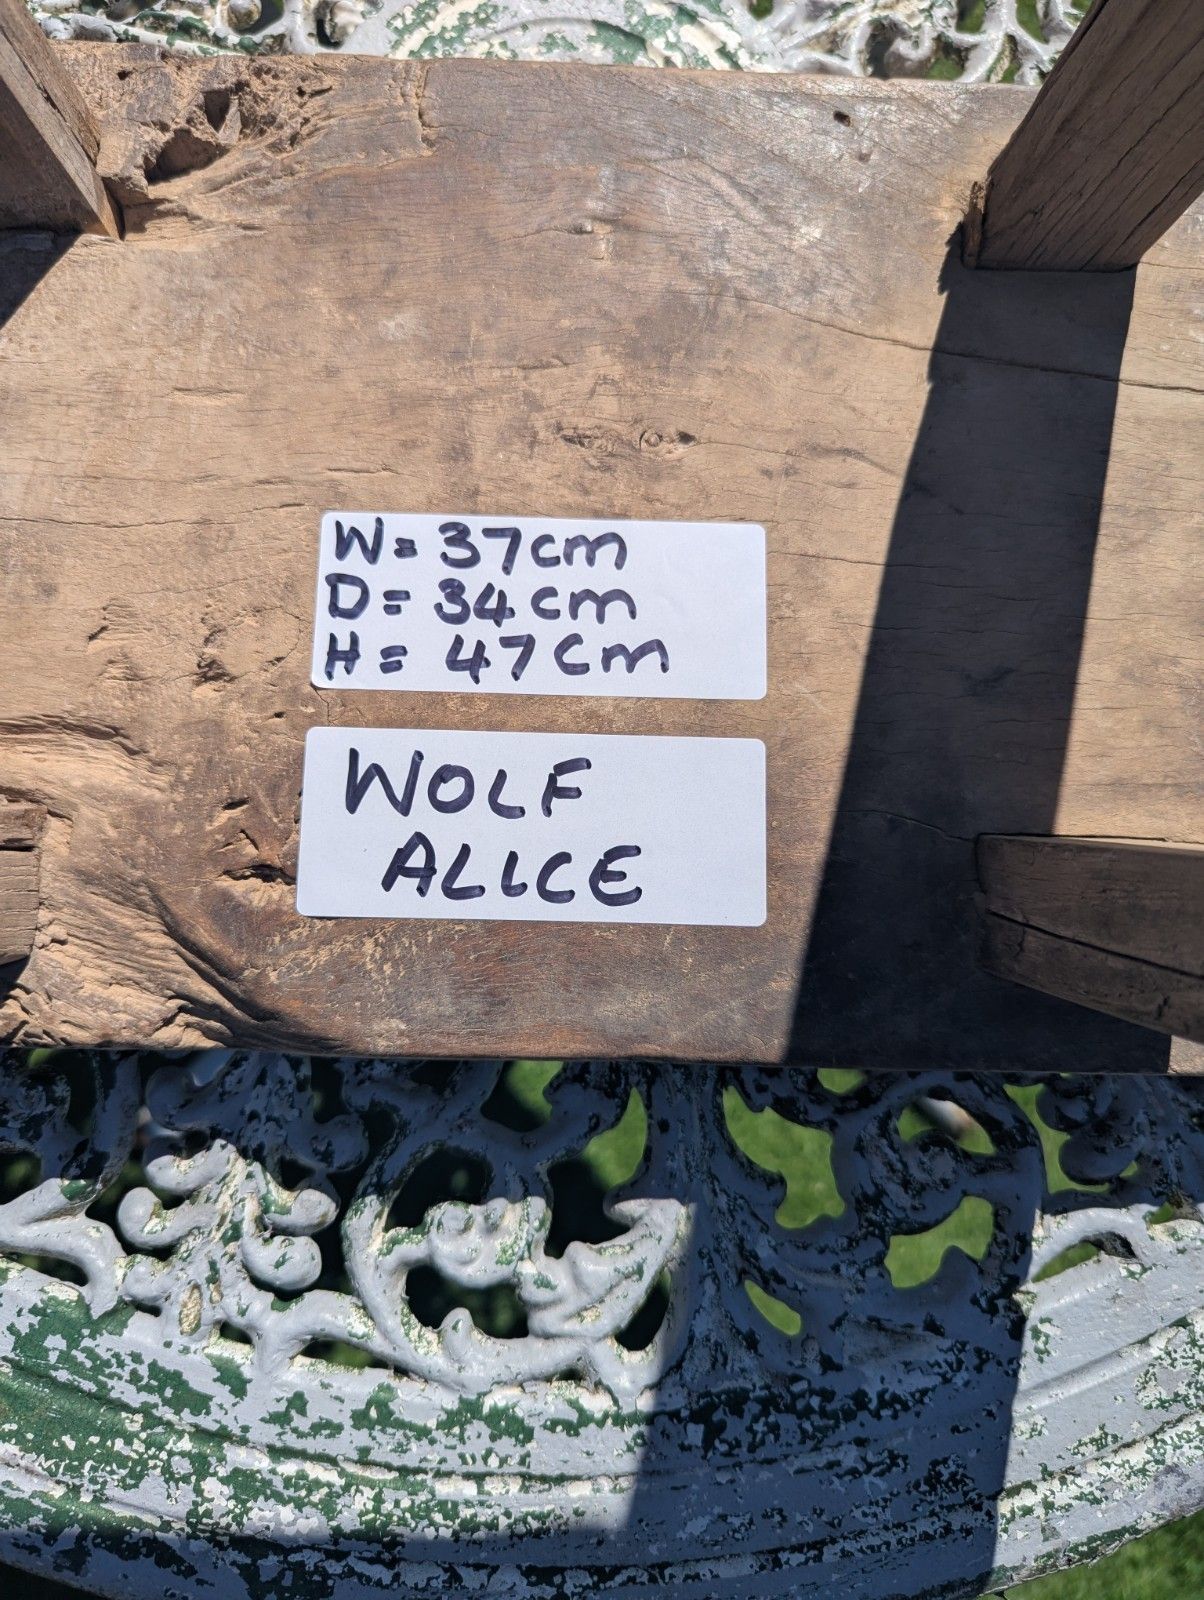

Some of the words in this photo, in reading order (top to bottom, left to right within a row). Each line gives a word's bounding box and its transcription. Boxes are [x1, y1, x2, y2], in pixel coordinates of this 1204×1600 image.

[335, 516, 418, 565] W=
[324, 572, 411, 620] D=
[345, 747, 592, 819] WOLF
[380, 831, 643, 907] ALICE
